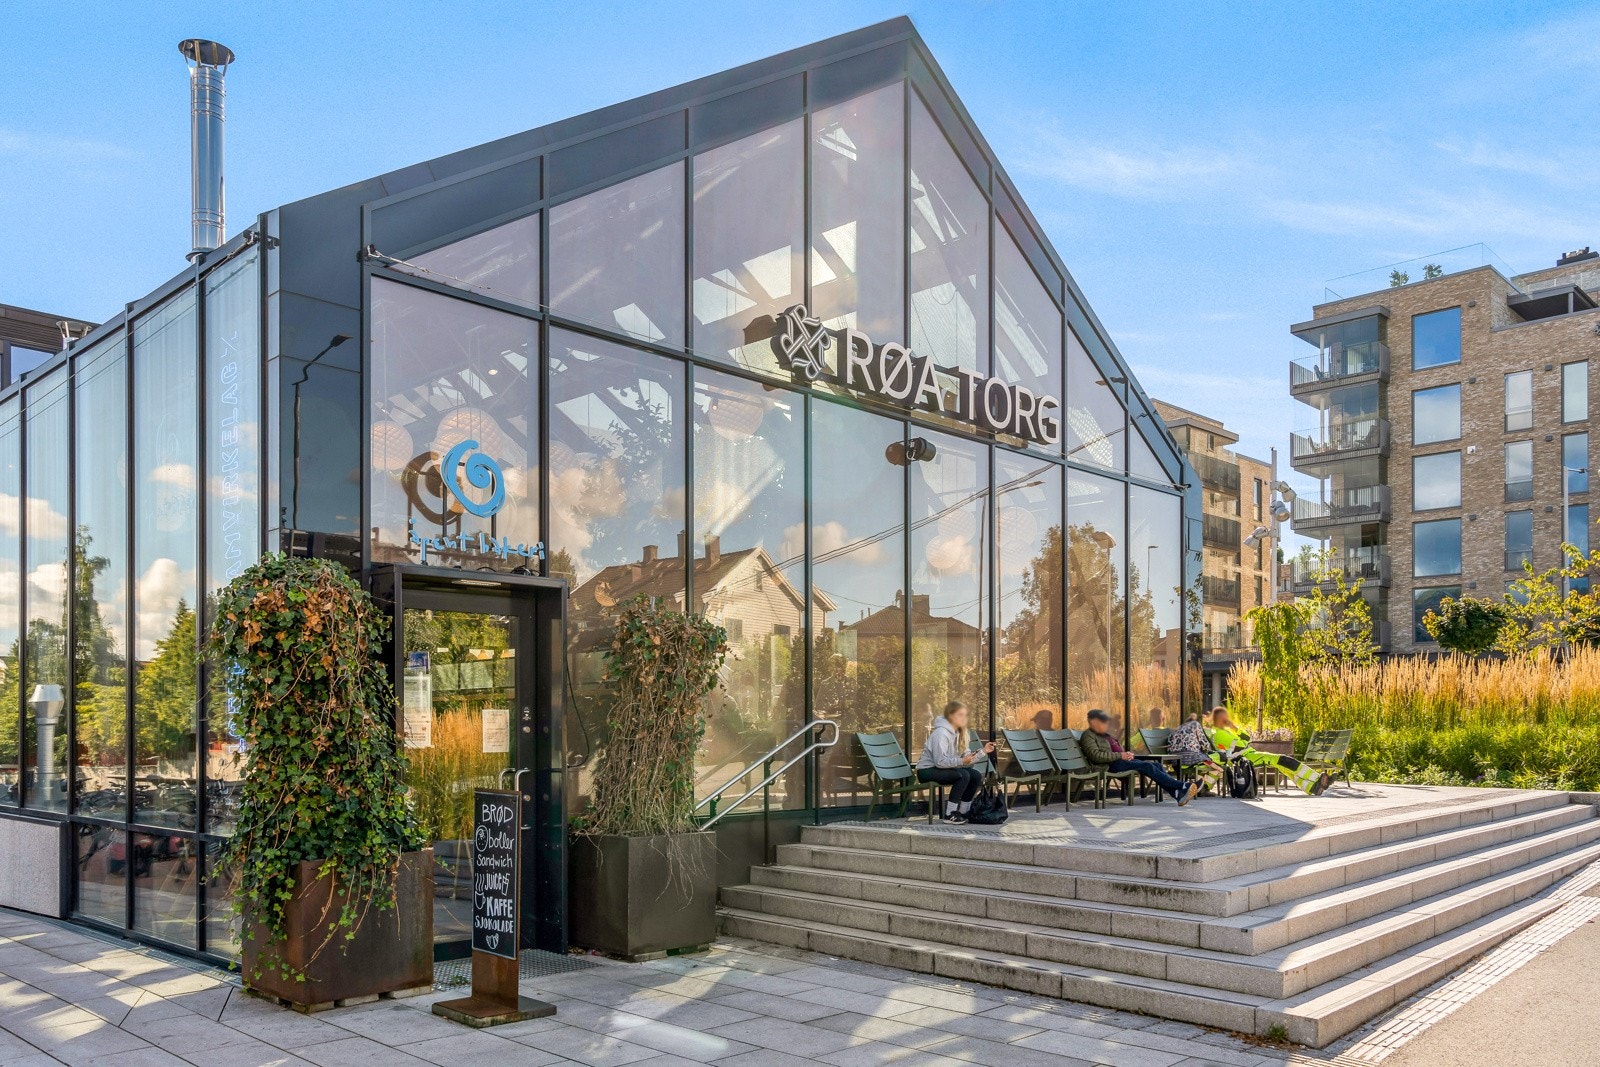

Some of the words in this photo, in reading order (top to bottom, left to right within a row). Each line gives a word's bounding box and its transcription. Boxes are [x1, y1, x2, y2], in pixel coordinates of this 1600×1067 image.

[846, 328, 945, 411] RØA
[959, 367, 1060, 444] TORG
[220, 361, 242, 581] AMVIRKELAG
[482, 803, 514, 826] BRØD
[488, 828, 515, 850] boller
[486, 896, 513, 918] KAFFE
[475, 915, 514, 934] SJOKOLADE
